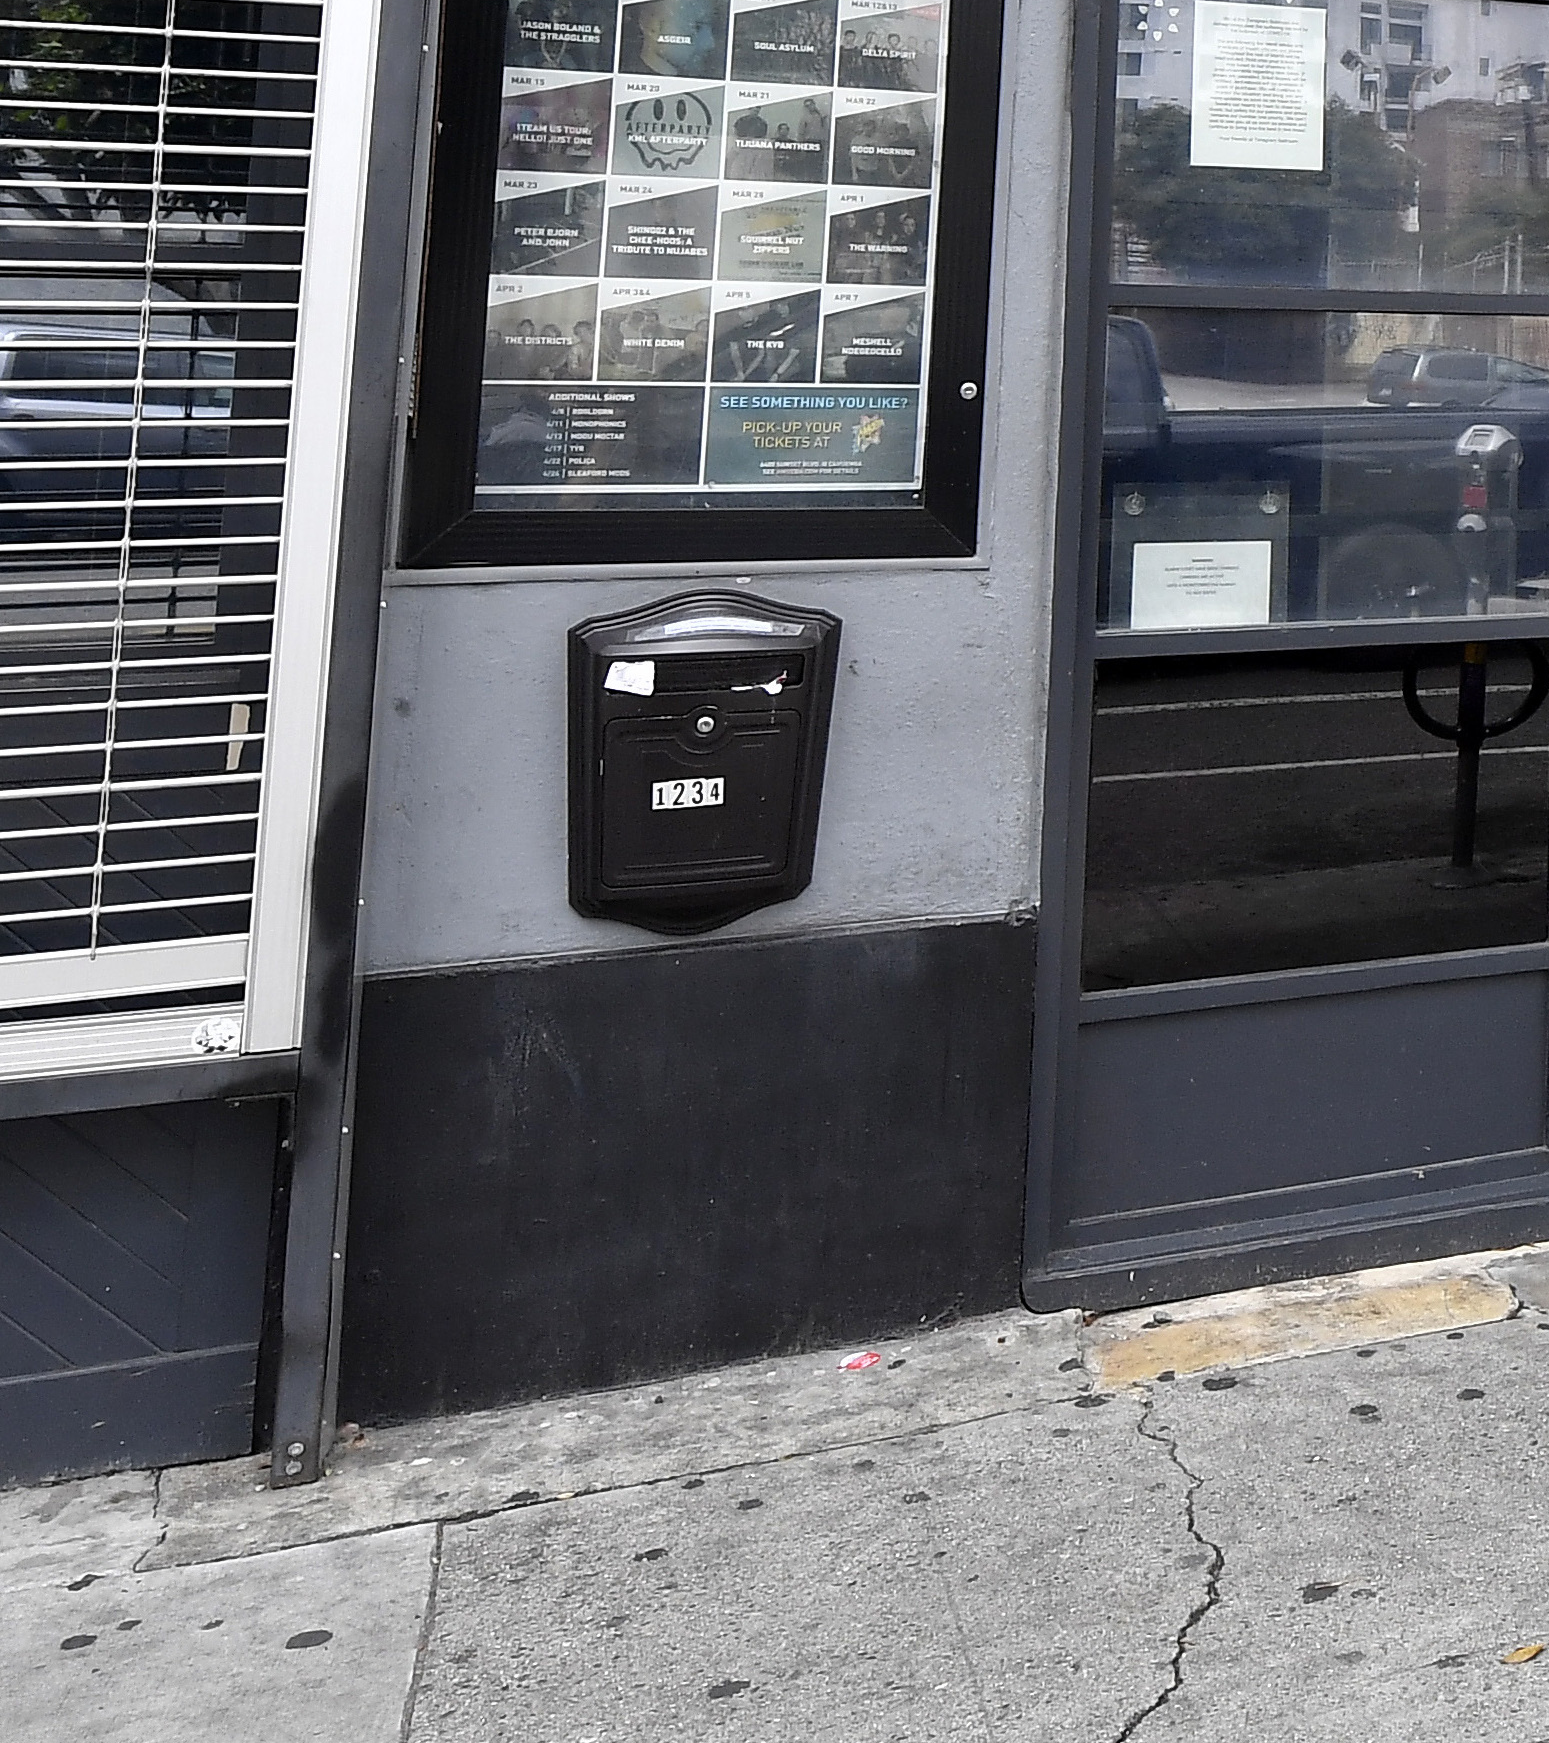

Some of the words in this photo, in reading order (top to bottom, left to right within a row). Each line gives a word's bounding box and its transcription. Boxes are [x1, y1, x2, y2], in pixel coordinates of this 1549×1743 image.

[851, 0, 871, 9] MAR
[519, 29, 538, 40] THE
[754, 40, 777, 51] SOUL
[778, 42, 815, 54] ASYLUM
[861, 47, 888, 58] DELTA
[511, 75, 531, 86] MAR
[627, 83, 648, 92] MAR
[738, 90, 759, 100] MAR
[845, 97, 865, 106] MAR
[625, 122, 711, 136] AFTERPARTY
[573, 136, 594, 147] ONE
[648, 134, 709, 147] AFTERPARTY
[774, 141, 821, 152] PANTHERS
[503, 179, 525, 189] MAR
[619, 185, 641, 194] MAR
[677, 226, 696, 236] THE
[652, 246, 665, 256] TO
[848, 243, 866, 252] THE
[504, 336, 524, 345] THE
[746, 340, 765, 349] THE
[548, 393, 602, 402] ADDITIONAL
[603, 393, 636, 403] SHOWS
[720, 396, 750, 408] SEE
[751, 396, 835, 408] SOMETHING
[837, 397, 867, 408] YOU
[869, 397, 908, 409] LIKE?
[742, 422, 802, 433] PICK-UP
[805, 422, 842, 434] YOUR
[753, 436, 811, 448] TICKETS
[813, 437, 831, 448] AT
[655, 781, 722, 808] 1234
